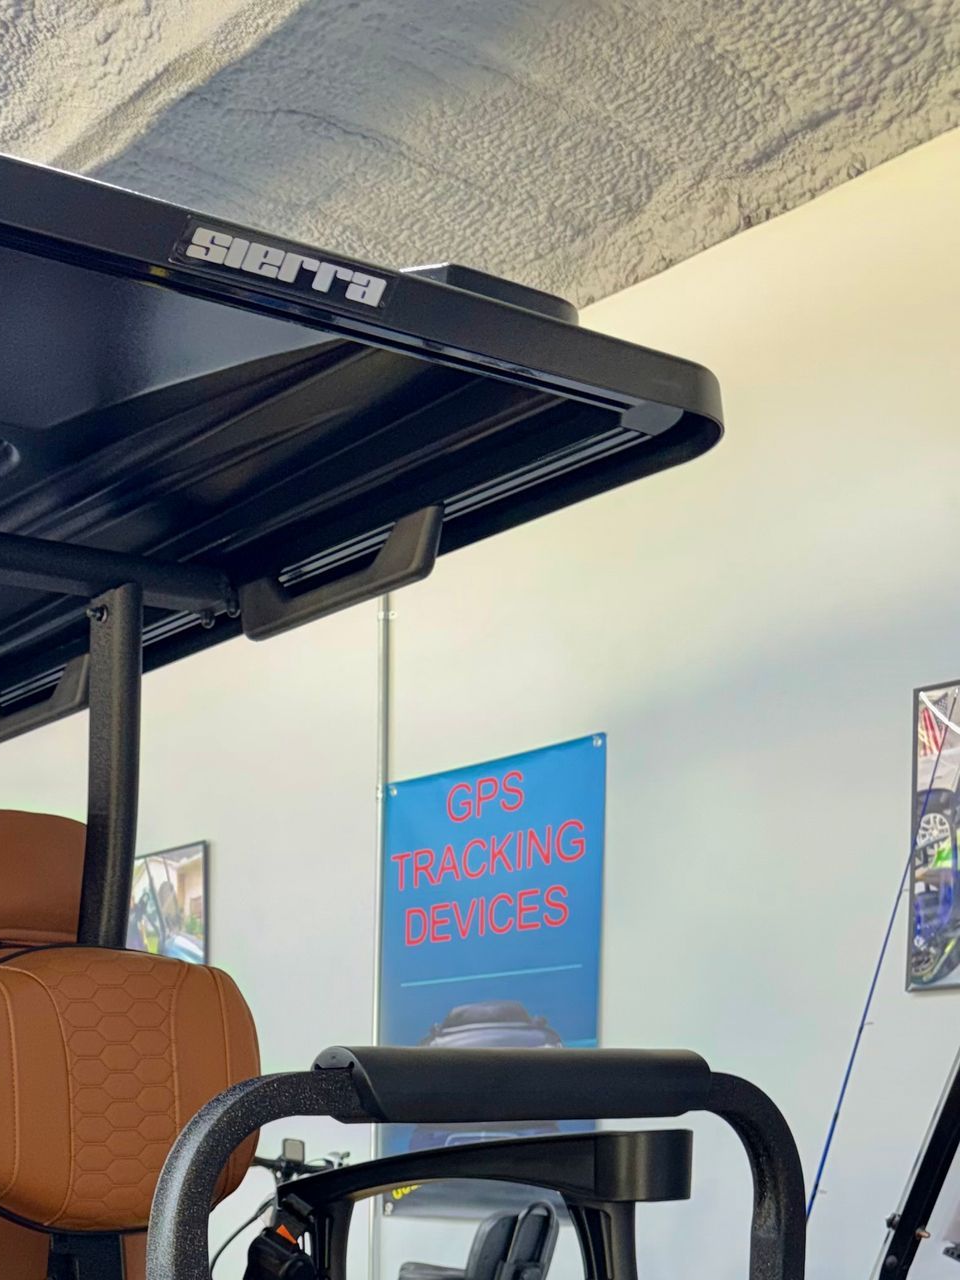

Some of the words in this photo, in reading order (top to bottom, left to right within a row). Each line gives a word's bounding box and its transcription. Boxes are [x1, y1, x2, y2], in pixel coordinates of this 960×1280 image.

[446, 771, 525, 822] GPS
[392, 819, 586, 891] TRACKING
[404, 885, 569, 947] DEVICES
